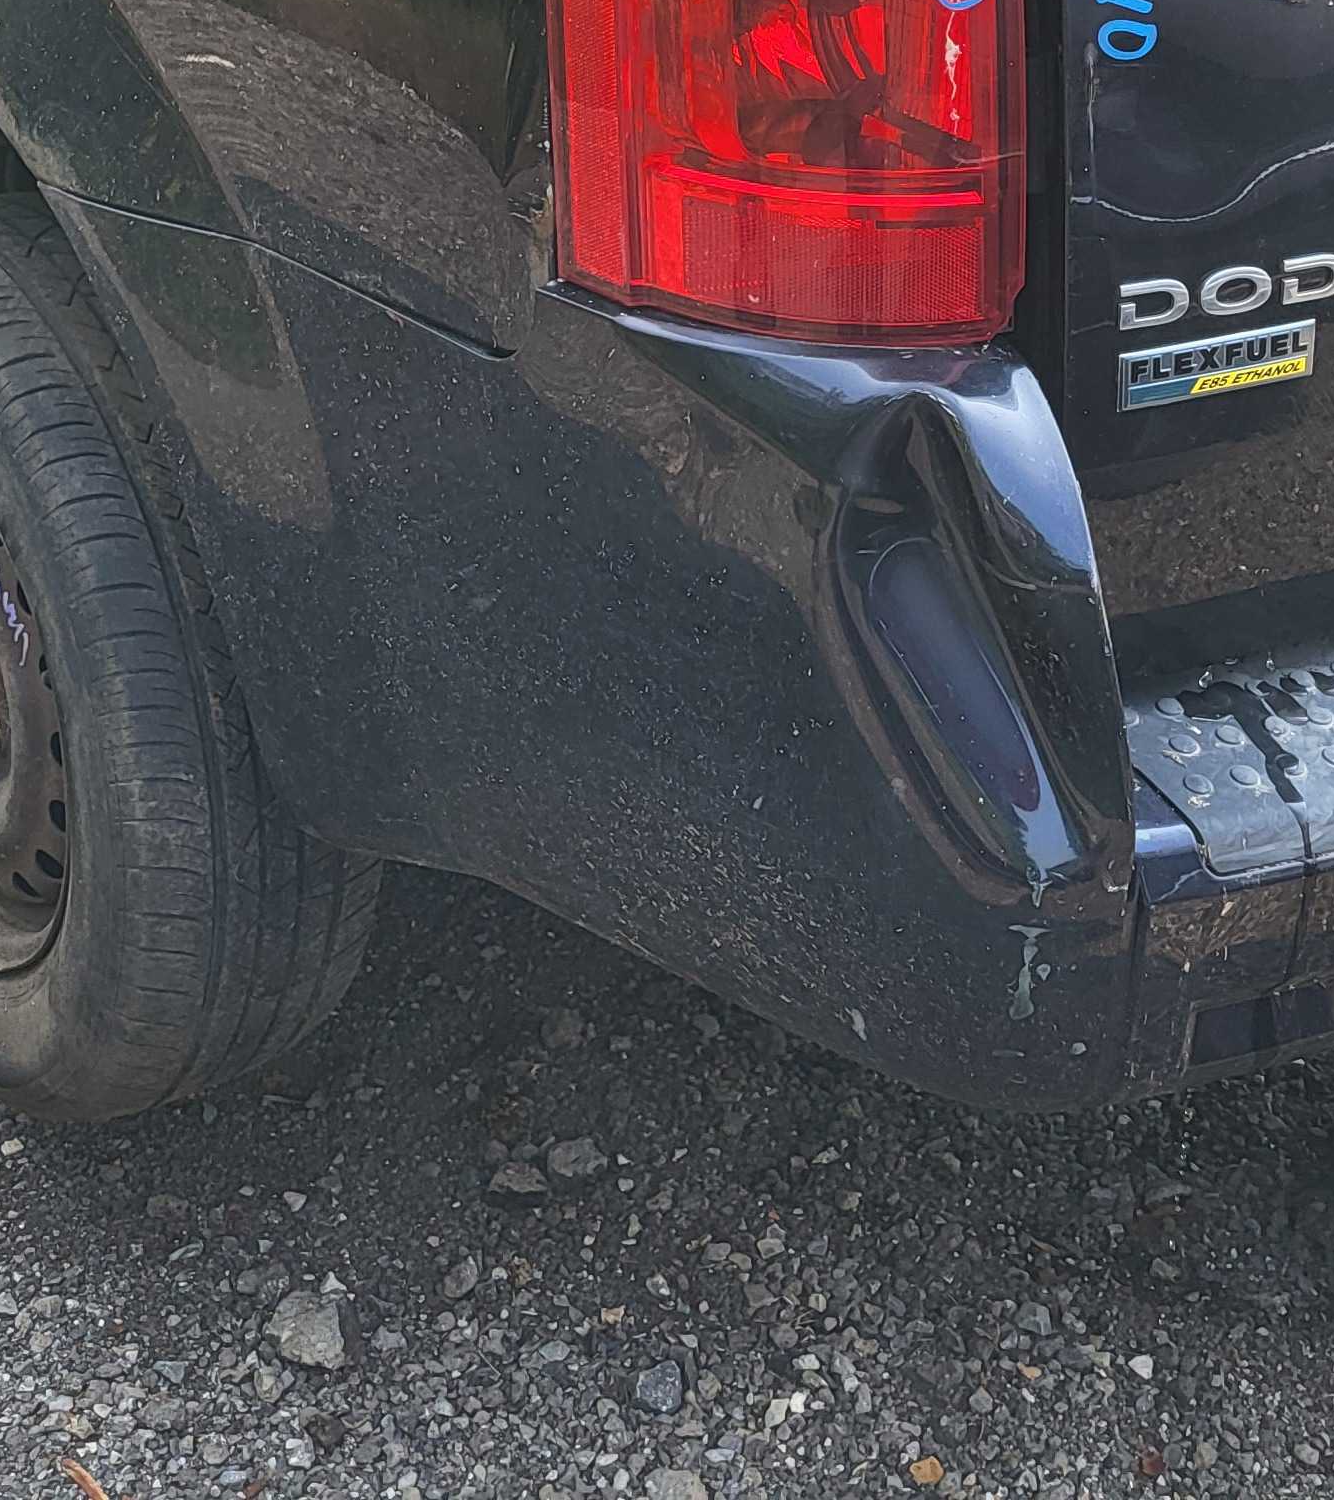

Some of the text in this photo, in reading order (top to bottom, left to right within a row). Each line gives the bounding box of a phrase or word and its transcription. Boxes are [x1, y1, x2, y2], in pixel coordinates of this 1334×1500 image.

[1129, 329, 1309, 384] FLEXFUEL
[1196, 360, 1303, 392] E85 ETHANOL
